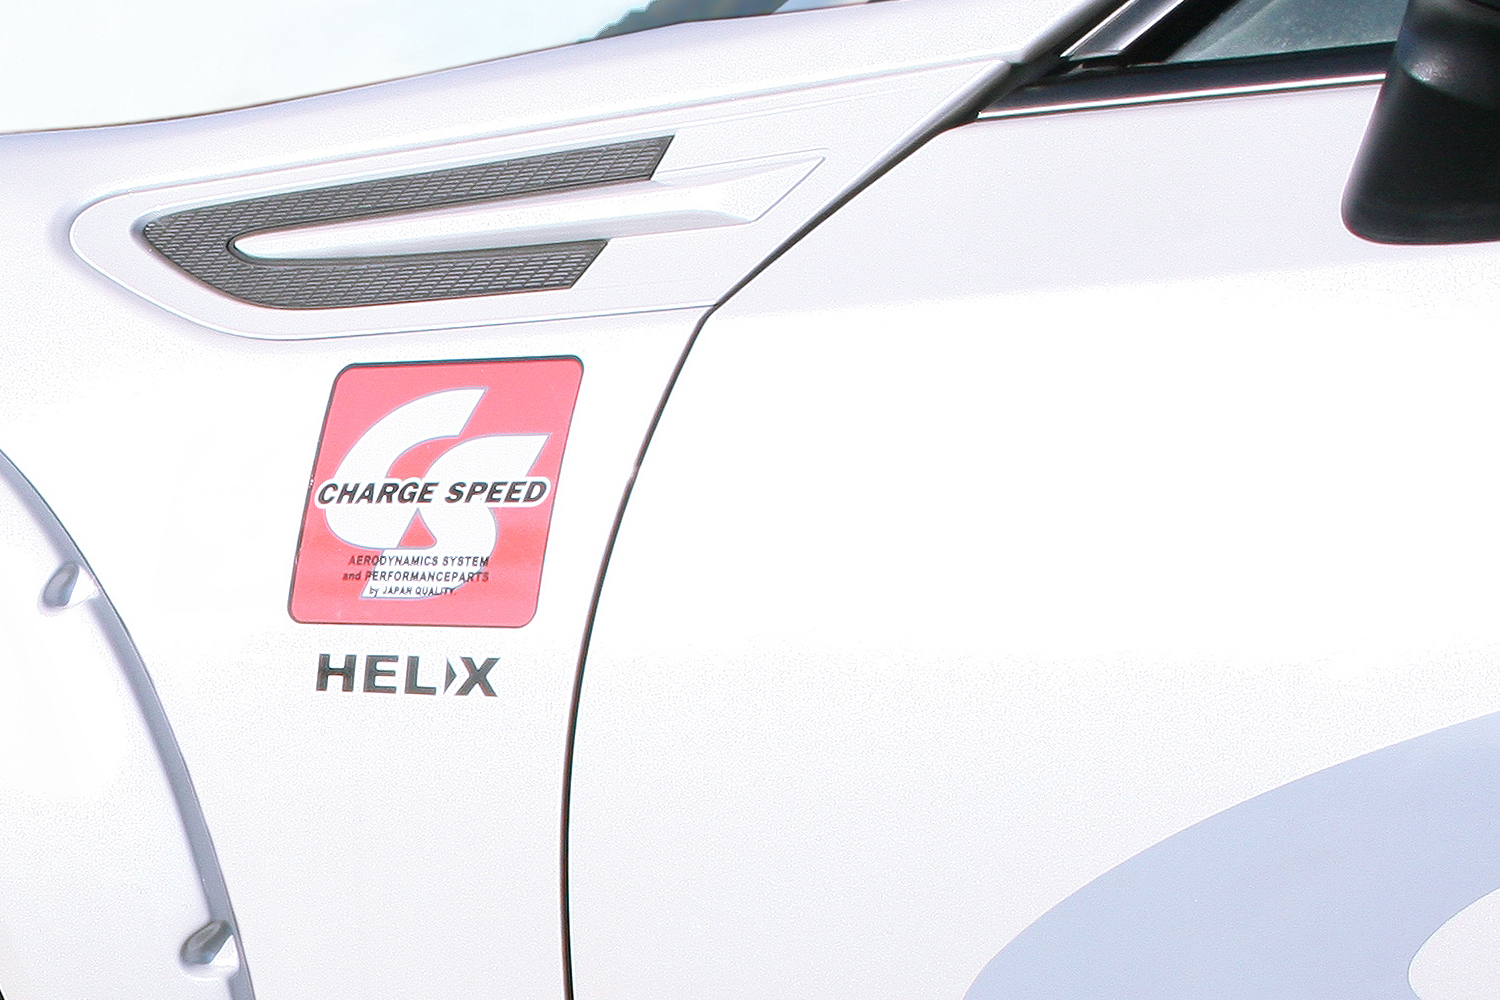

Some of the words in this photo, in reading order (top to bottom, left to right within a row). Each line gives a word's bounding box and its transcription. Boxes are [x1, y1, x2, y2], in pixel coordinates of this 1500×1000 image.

[318, 482, 439, 504] CHARGE
[444, 481, 547, 503] SPEED
[348, 555, 438, 566] AERODYNAMICS
[442, 556, 490, 567] SYSTEM
[342, 571, 361, 581] and
[369, 587, 379, 597] by
[382, 587, 412, 595] JAPAN
